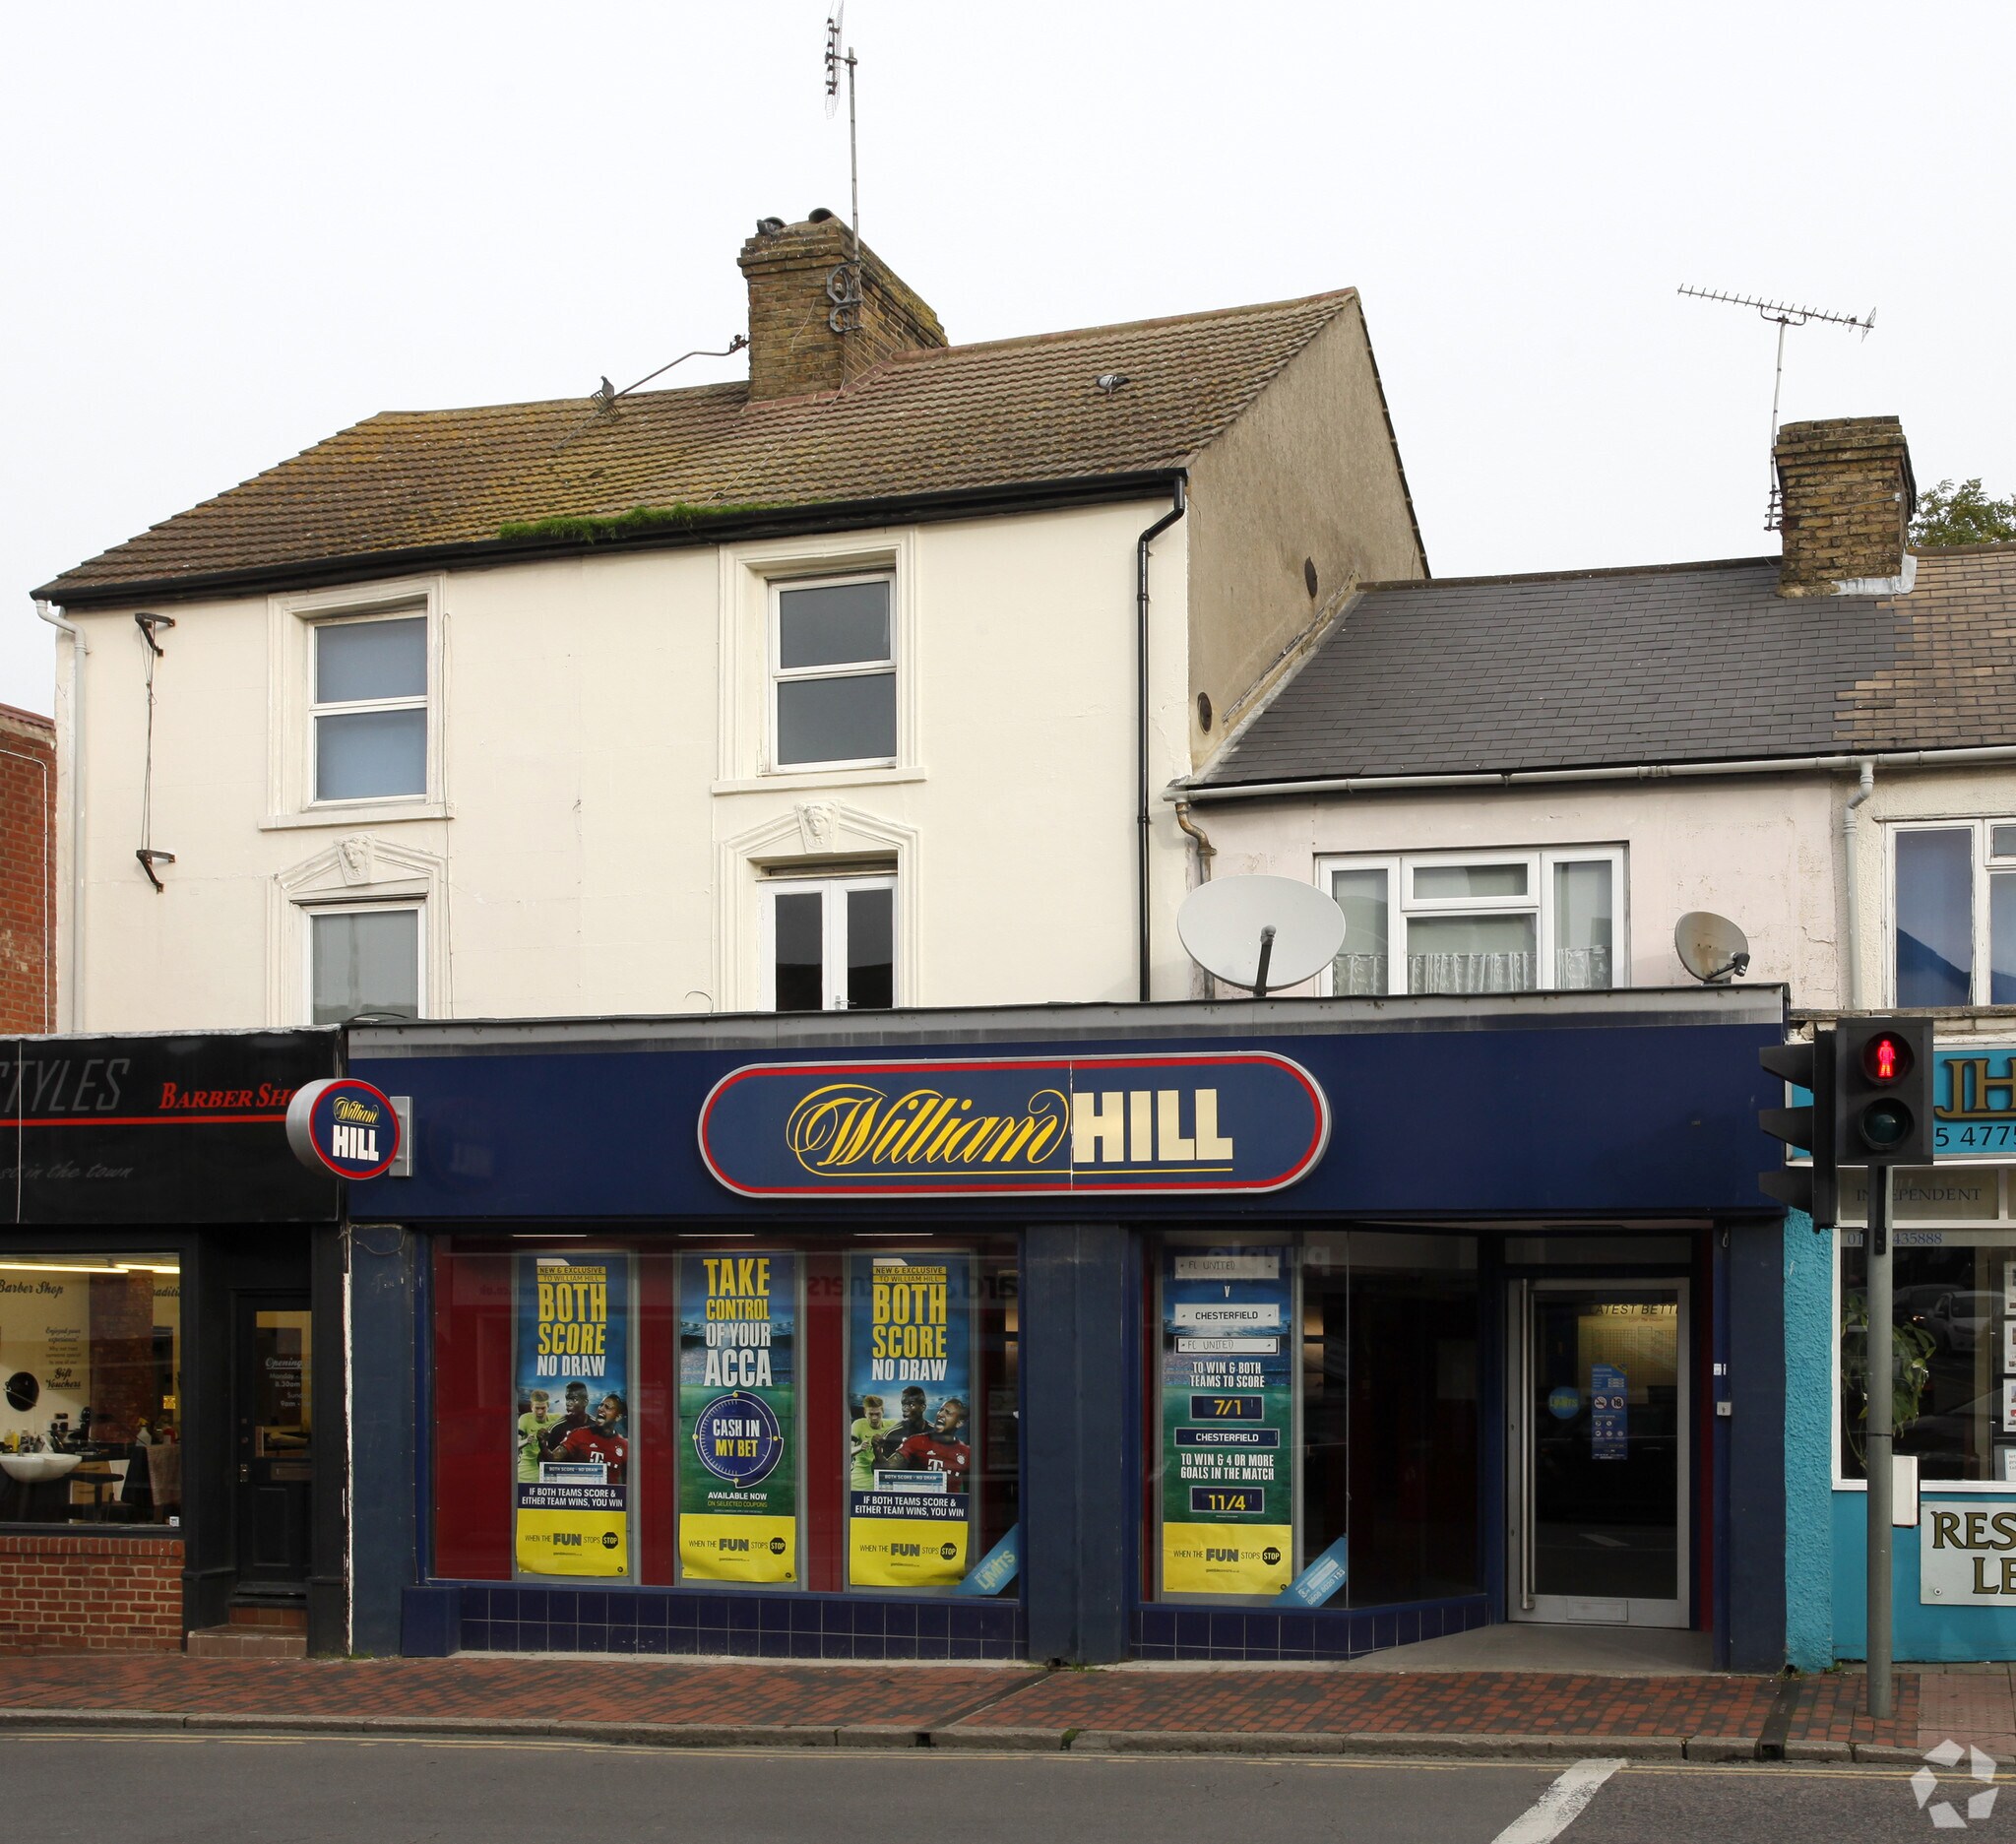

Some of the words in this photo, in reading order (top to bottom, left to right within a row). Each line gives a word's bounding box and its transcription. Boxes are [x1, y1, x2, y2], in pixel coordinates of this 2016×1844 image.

[0, 1058, 130, 1113] TYLES
[333, 1096, 380, 1124] William
[787, 1084, 1070, 1169] William
[1073, 1089, 1233, 1164] HILL
[333, 1125, 379, 1161] HILL
[47, 1160, 80, 1179] the
[86, 1163, 134, 1179] town
[1203, 1261, 1235, 1270] UNITED
[703, 1258, 771, 1297] TAKE
[36, 1281, 64, 1299] Shop
[1224, 1285, 1230, 1298] V
[537, 1283, 607, 1322] BOTH
[706, 1299, 771, 1320] CONTROL
[872, 1283, 947, 1325] BOTH
[1195, 1311, 1258, 1320] CHESTERFIELD
[537, 1322, 606, 1355] SCORE
[706, 1322, 725, 1347] OF
[728, 1322, 771, 1347] YOUR
[872, 1324, 947, 1359] SCORE
[1203, 1340, 1233, 1350] UNITED
[536, 1356, 557, 1376] NO
[561, 1356, 605, 1376] DRAW
[703, 1349, 773, 1387] ACCA
[871, 1358, 895, 1381] NO
[899, 1359, 948, 1381] DRAW
[1192, 1362, 1205, 1373] TO
[1206, 1362, 1227, 1373] WIN
[1228, 1363, 1236, 1373] &
[1238, 1362, 1262, 1374] BOTH
[1190, 1374, 1221, 1387] TEAMS
[1223, 1374, 1235, 1387] TO
[1236, 1374, 1265, 1388] SCORE
[1214, 1399, 1242, 1416] 7/1
[713, 1419, 743, 1437] CASH
[746, 1419, 761, 1437] IN
[1195, 1432, 1259, 1442] CHESTERFIELD
[715, 1439, 734, 1457] MY
[737, 1439, 759, 1458] BET
[1181, 1453, 1192, 1466] TO
[1194, 1453, 1215, 1466] WIN
[1217, 1454, 1225, 1466] &
[1226, 1454, 1232, 1466] 4
[1234, 1455, 1246, 1466] OR
[1248, 1455, 1275, 1467] MORE
[1181, 1467, 1209, 1479] GOALS
[1211, 1467, 1222, 1479] IN
[1224, 1468, 1240, 1480] THE
[1241, 1468, 1275, 1481] MATCH
[537, 1488, 556, 1496] BOTH
[584, 1489, 608, 1497] SCORE
[708, 1492, 748, 1500] AVAILABLE
[863, 1495, 870, 1504] IF
[872, 1495, 892, 1505] BOTH
[894, 1496, 921, 1506] TEAMS
[922, 1497, 949, 1507] SCORE
[522, 1496, 545, 1505] EITHER
[568, 1497, 591, 1507] WINS,
[608, 1498, 623, 1507] WIN
[1209, 1494, 1246, 1511] 11/4
[855, 1505, 882, 1514] EITHER
[883, 1506, 905, 1515] TEAM
[906, 1506, 929, 1517] WINS,
[930, 1507, 947, 1516] YOU
[948, 1508, 965, 1517] WIN
[553, 1533, 582, 1546] FUN
[719, 1538, 750, 1552] FUN
[891, 1543, 920, 1557] FUN
[941, 1547, 956, 1556] STOP
[1173, 1550, 1191, 1558] WHEN
[1206, 1549, 1239, 1562] FUN
[1263, 1553, 1280, 1561] STOP
